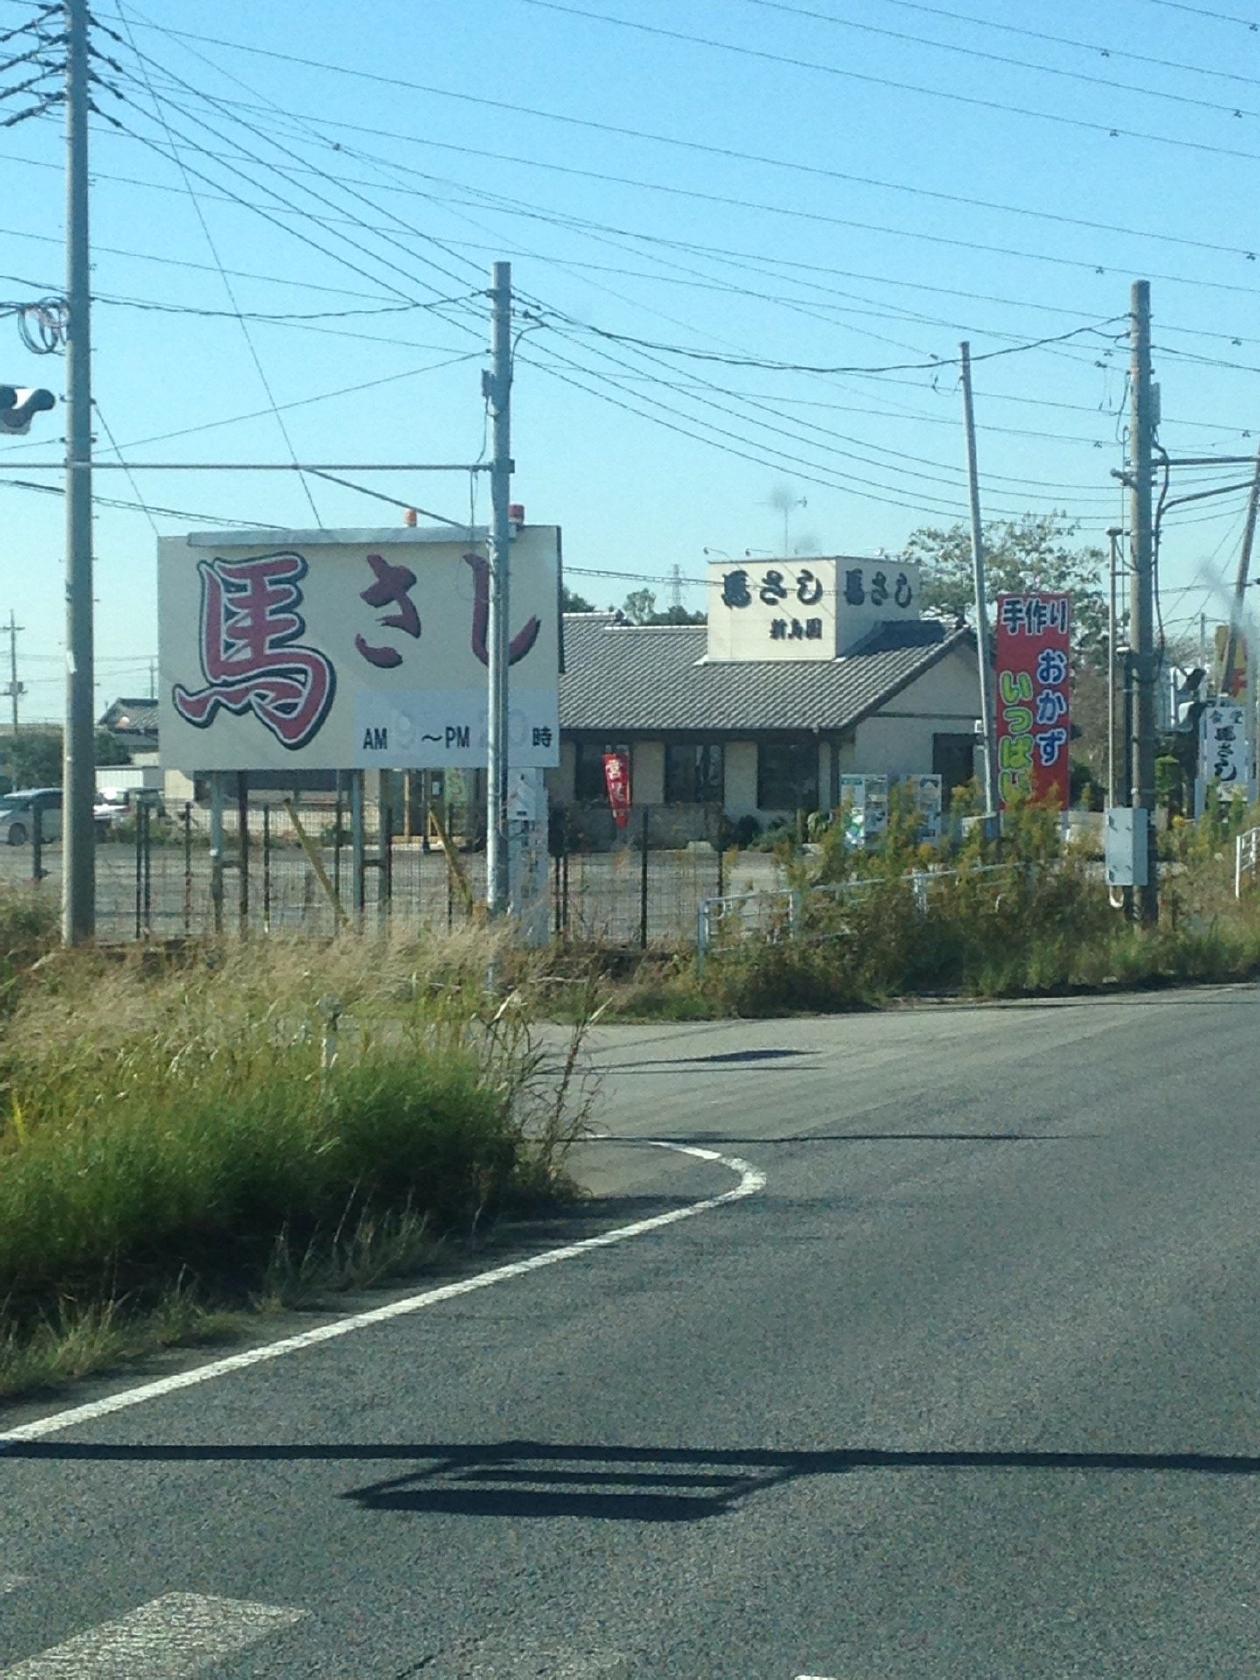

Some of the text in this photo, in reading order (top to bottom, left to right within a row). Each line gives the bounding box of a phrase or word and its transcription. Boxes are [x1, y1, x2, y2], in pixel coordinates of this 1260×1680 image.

[721, 568, 824, 609] 馬さし
[844, 568, 913, 608] 馬さし
[1002, 598, 1067, 635] 手作り
[172, 550, 541, 750] 馬さし
[1036, 648, 1067, 766] おかず
[363, 727, 388, 750] AM
[531, 726, 553, 748] 時
